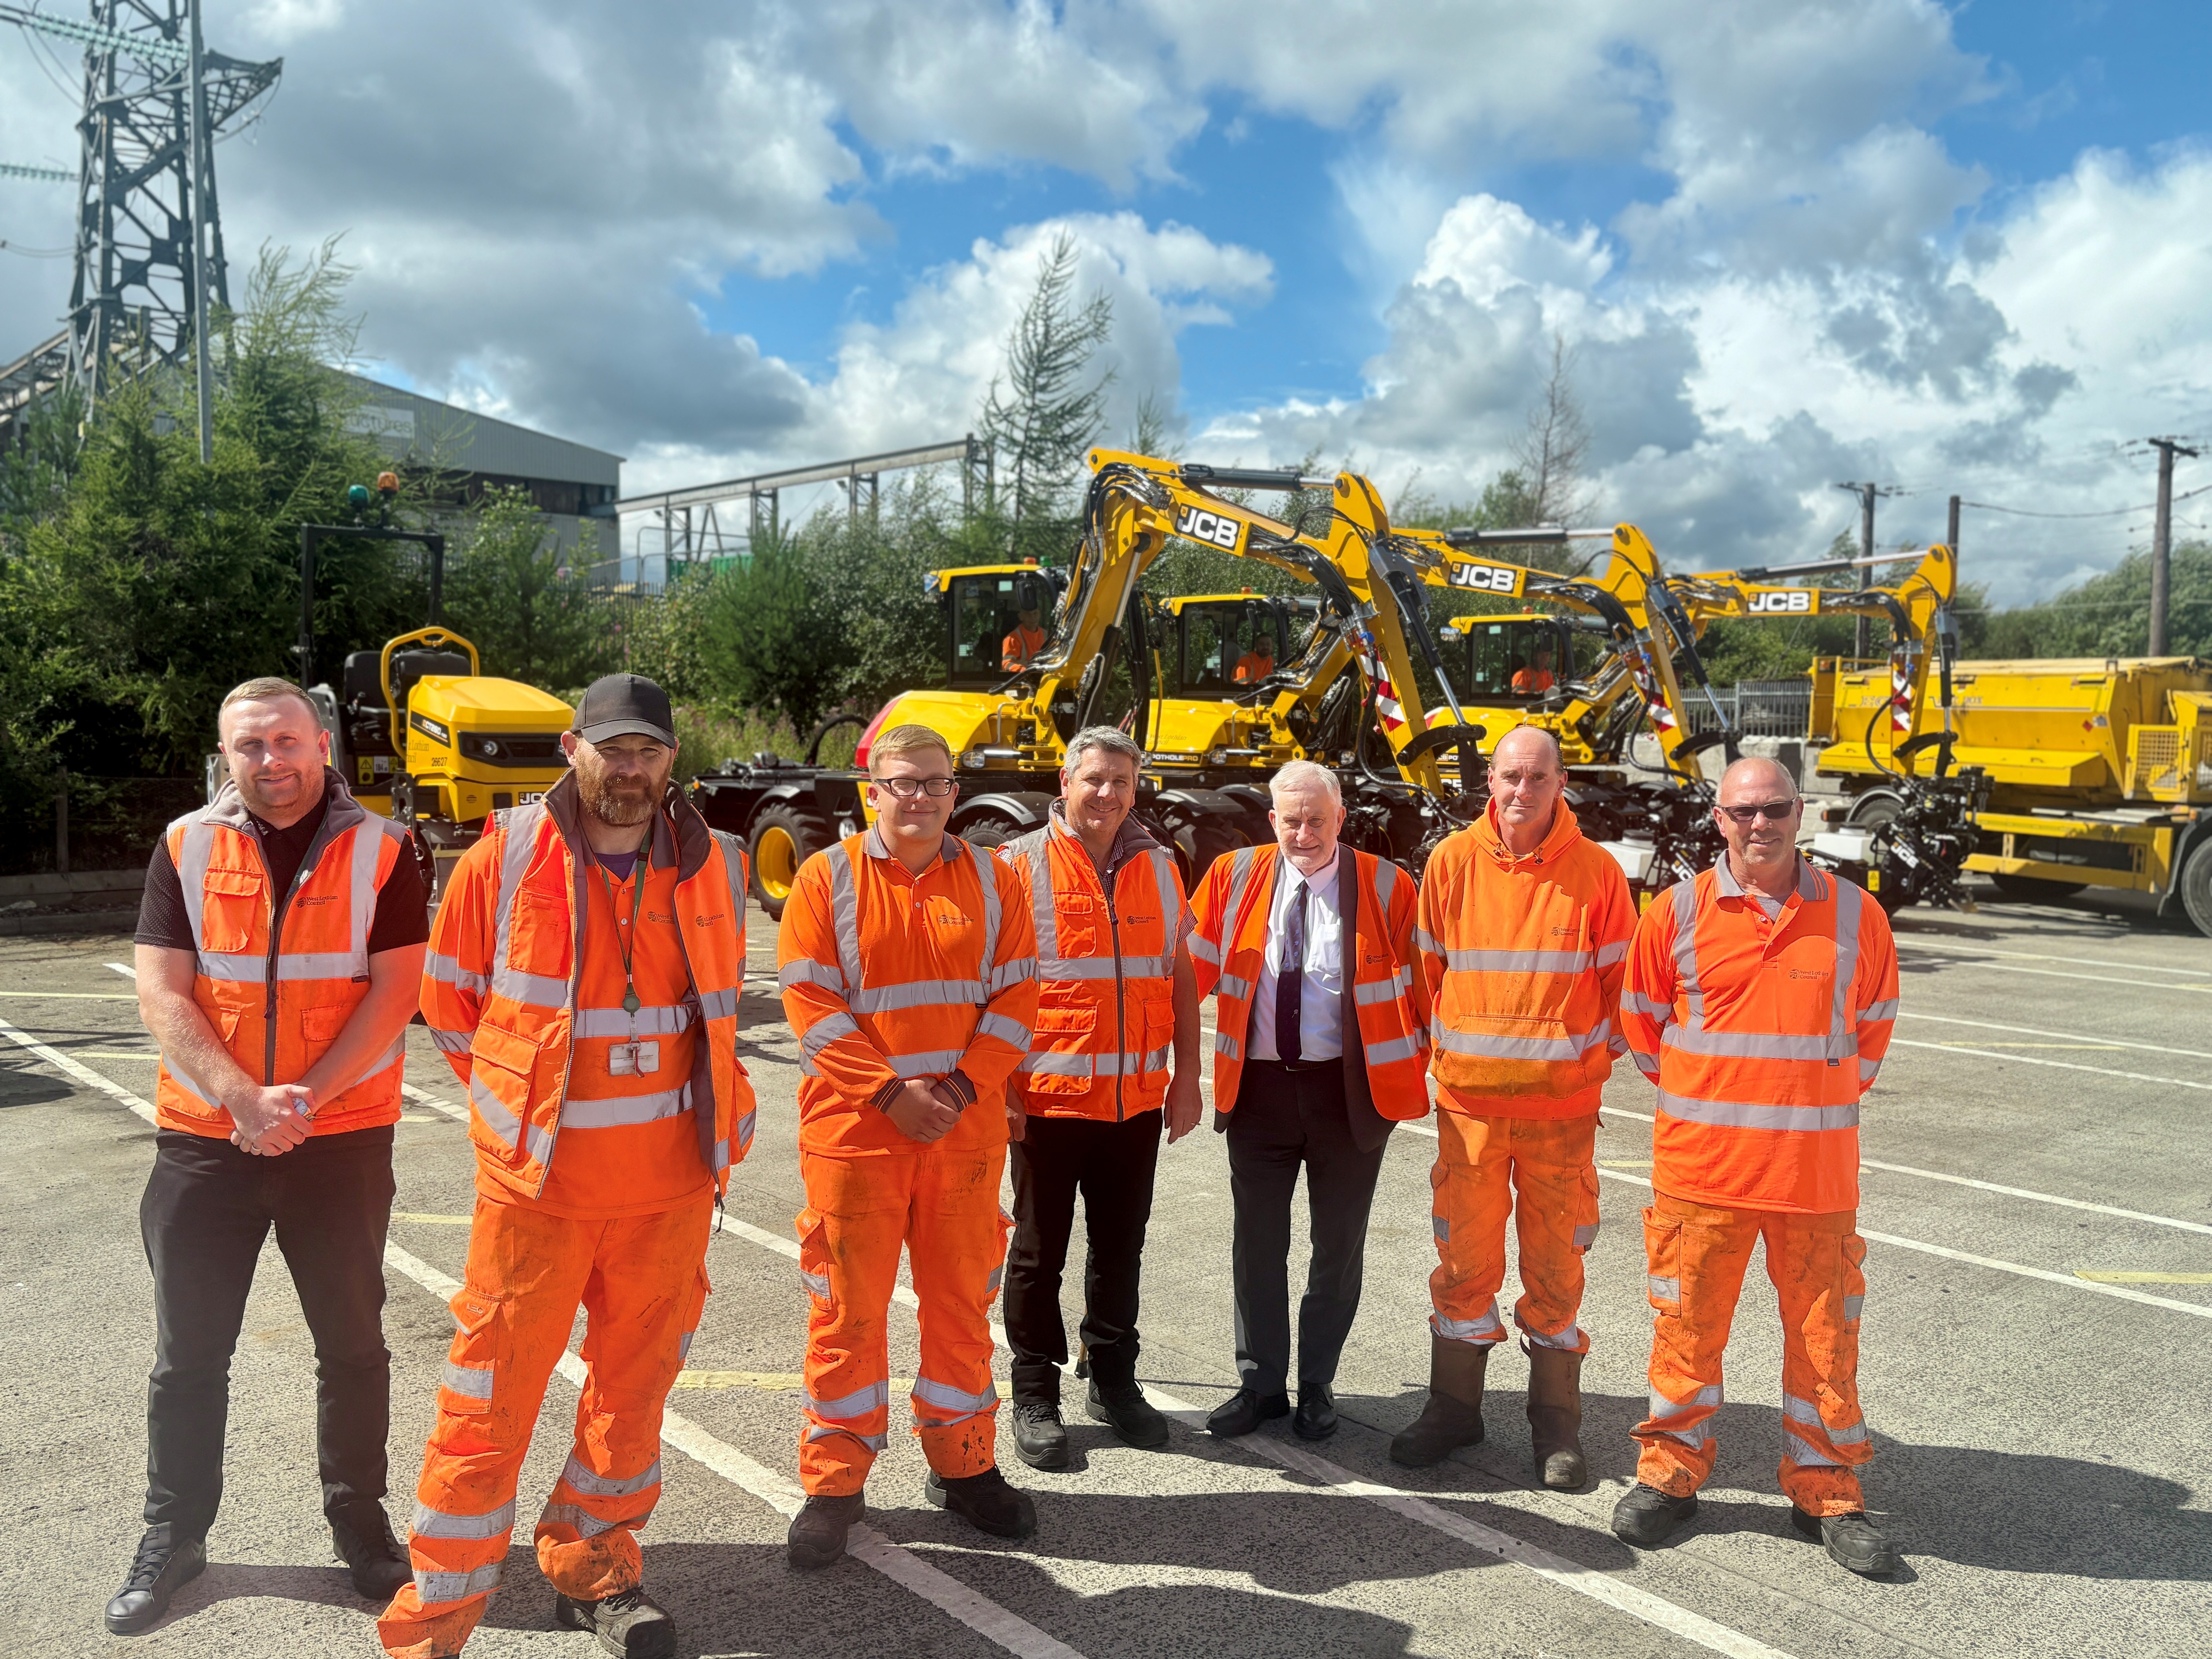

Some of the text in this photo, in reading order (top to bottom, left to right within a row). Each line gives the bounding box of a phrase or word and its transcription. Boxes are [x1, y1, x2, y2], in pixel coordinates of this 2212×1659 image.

[1177, 509, 1237, 547] JCB
[1451, 565, 1514, 591] JCB
[1748, 592, 1809, 611] JCB
[520, 793, 543, 804] JC
[1671, 864, 1692, 881] JC
